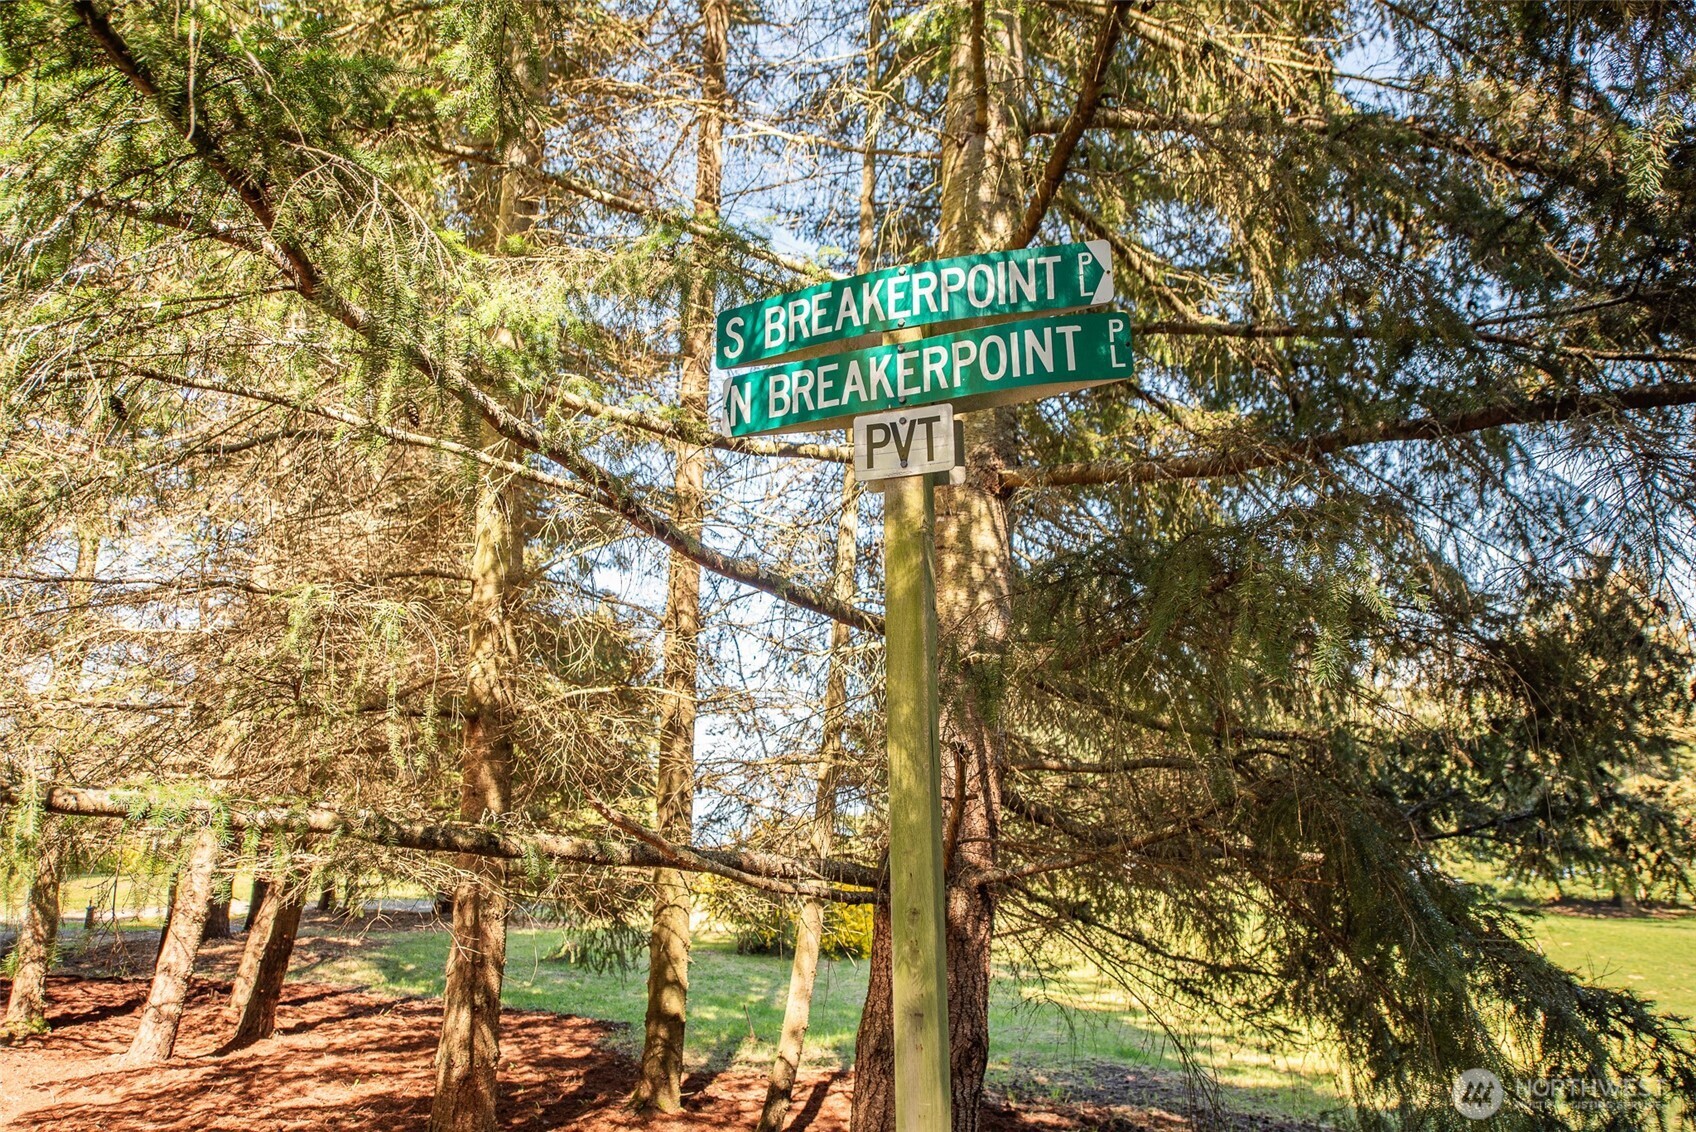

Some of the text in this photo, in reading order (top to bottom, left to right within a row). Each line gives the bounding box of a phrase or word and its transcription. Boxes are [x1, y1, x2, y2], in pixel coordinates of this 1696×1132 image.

[723, 251, 1094, 359] S BREAKERPOINT PL
[730, 318, 1126, 427] N BREAKERPOINT PL
[866, 415, 941, 470] PVT
